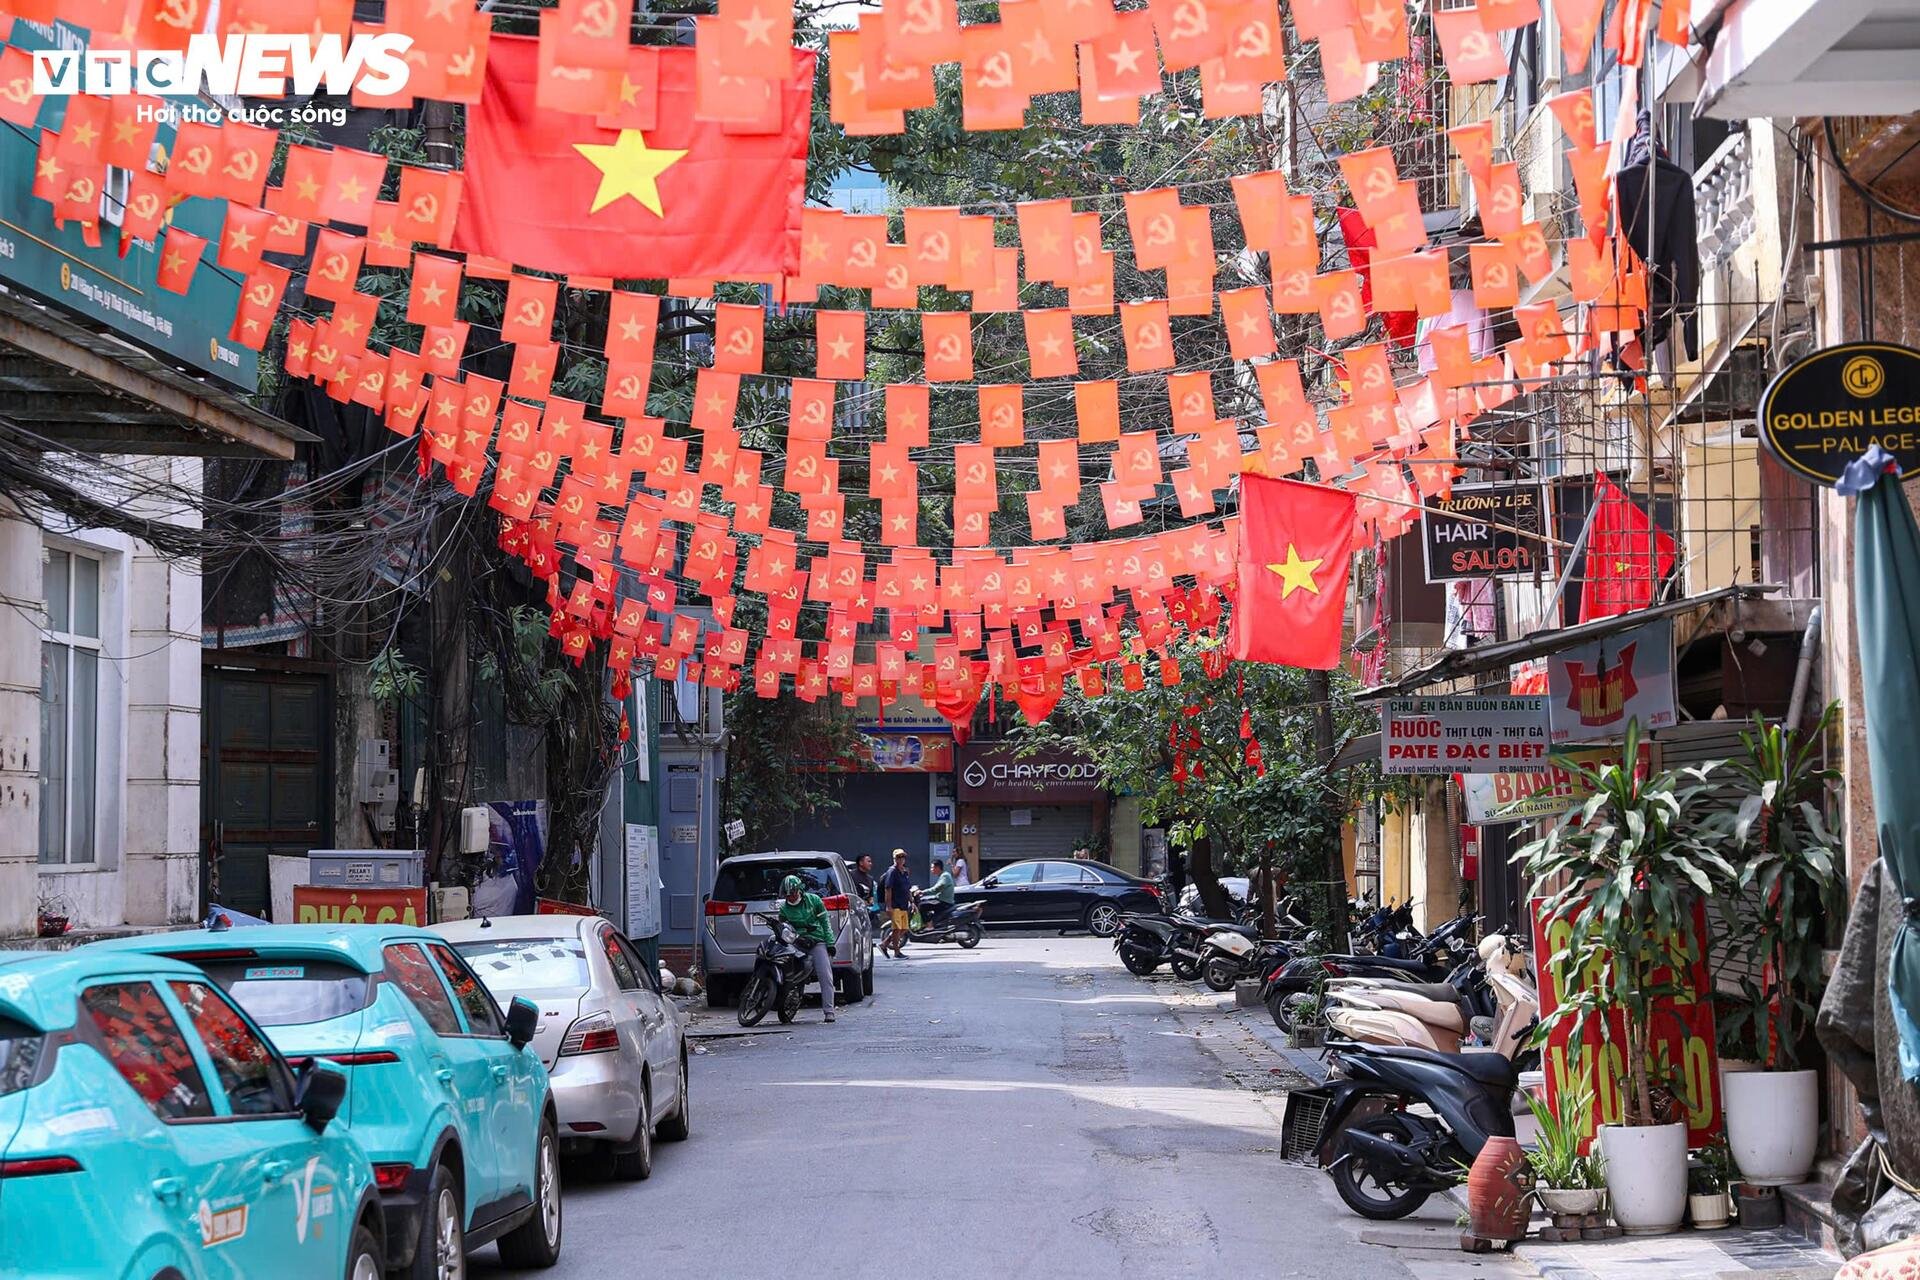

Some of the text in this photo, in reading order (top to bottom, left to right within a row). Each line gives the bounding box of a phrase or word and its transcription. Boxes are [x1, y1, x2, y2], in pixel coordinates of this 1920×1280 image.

[1773, 409, 1865, 431] GOLDEN
[1822, 433, 1915, 454] PALACE
[1505, 493, 1533, 508] LEE
[1434, 523, 1488, 544] HAIR
[1445, 727, 1468, 740] THỊT
[1471, 726, 1492, 740] LỢN
[1503, 727, 1526, 740] THỊT
[1389, 740, 1545, 762] PATE ĐẶC BIỆT
[991, 763, 1098, 779] CHAYFOOD
[993, 780, 1006, 788] for
[962, 824, 976, 834] 66
